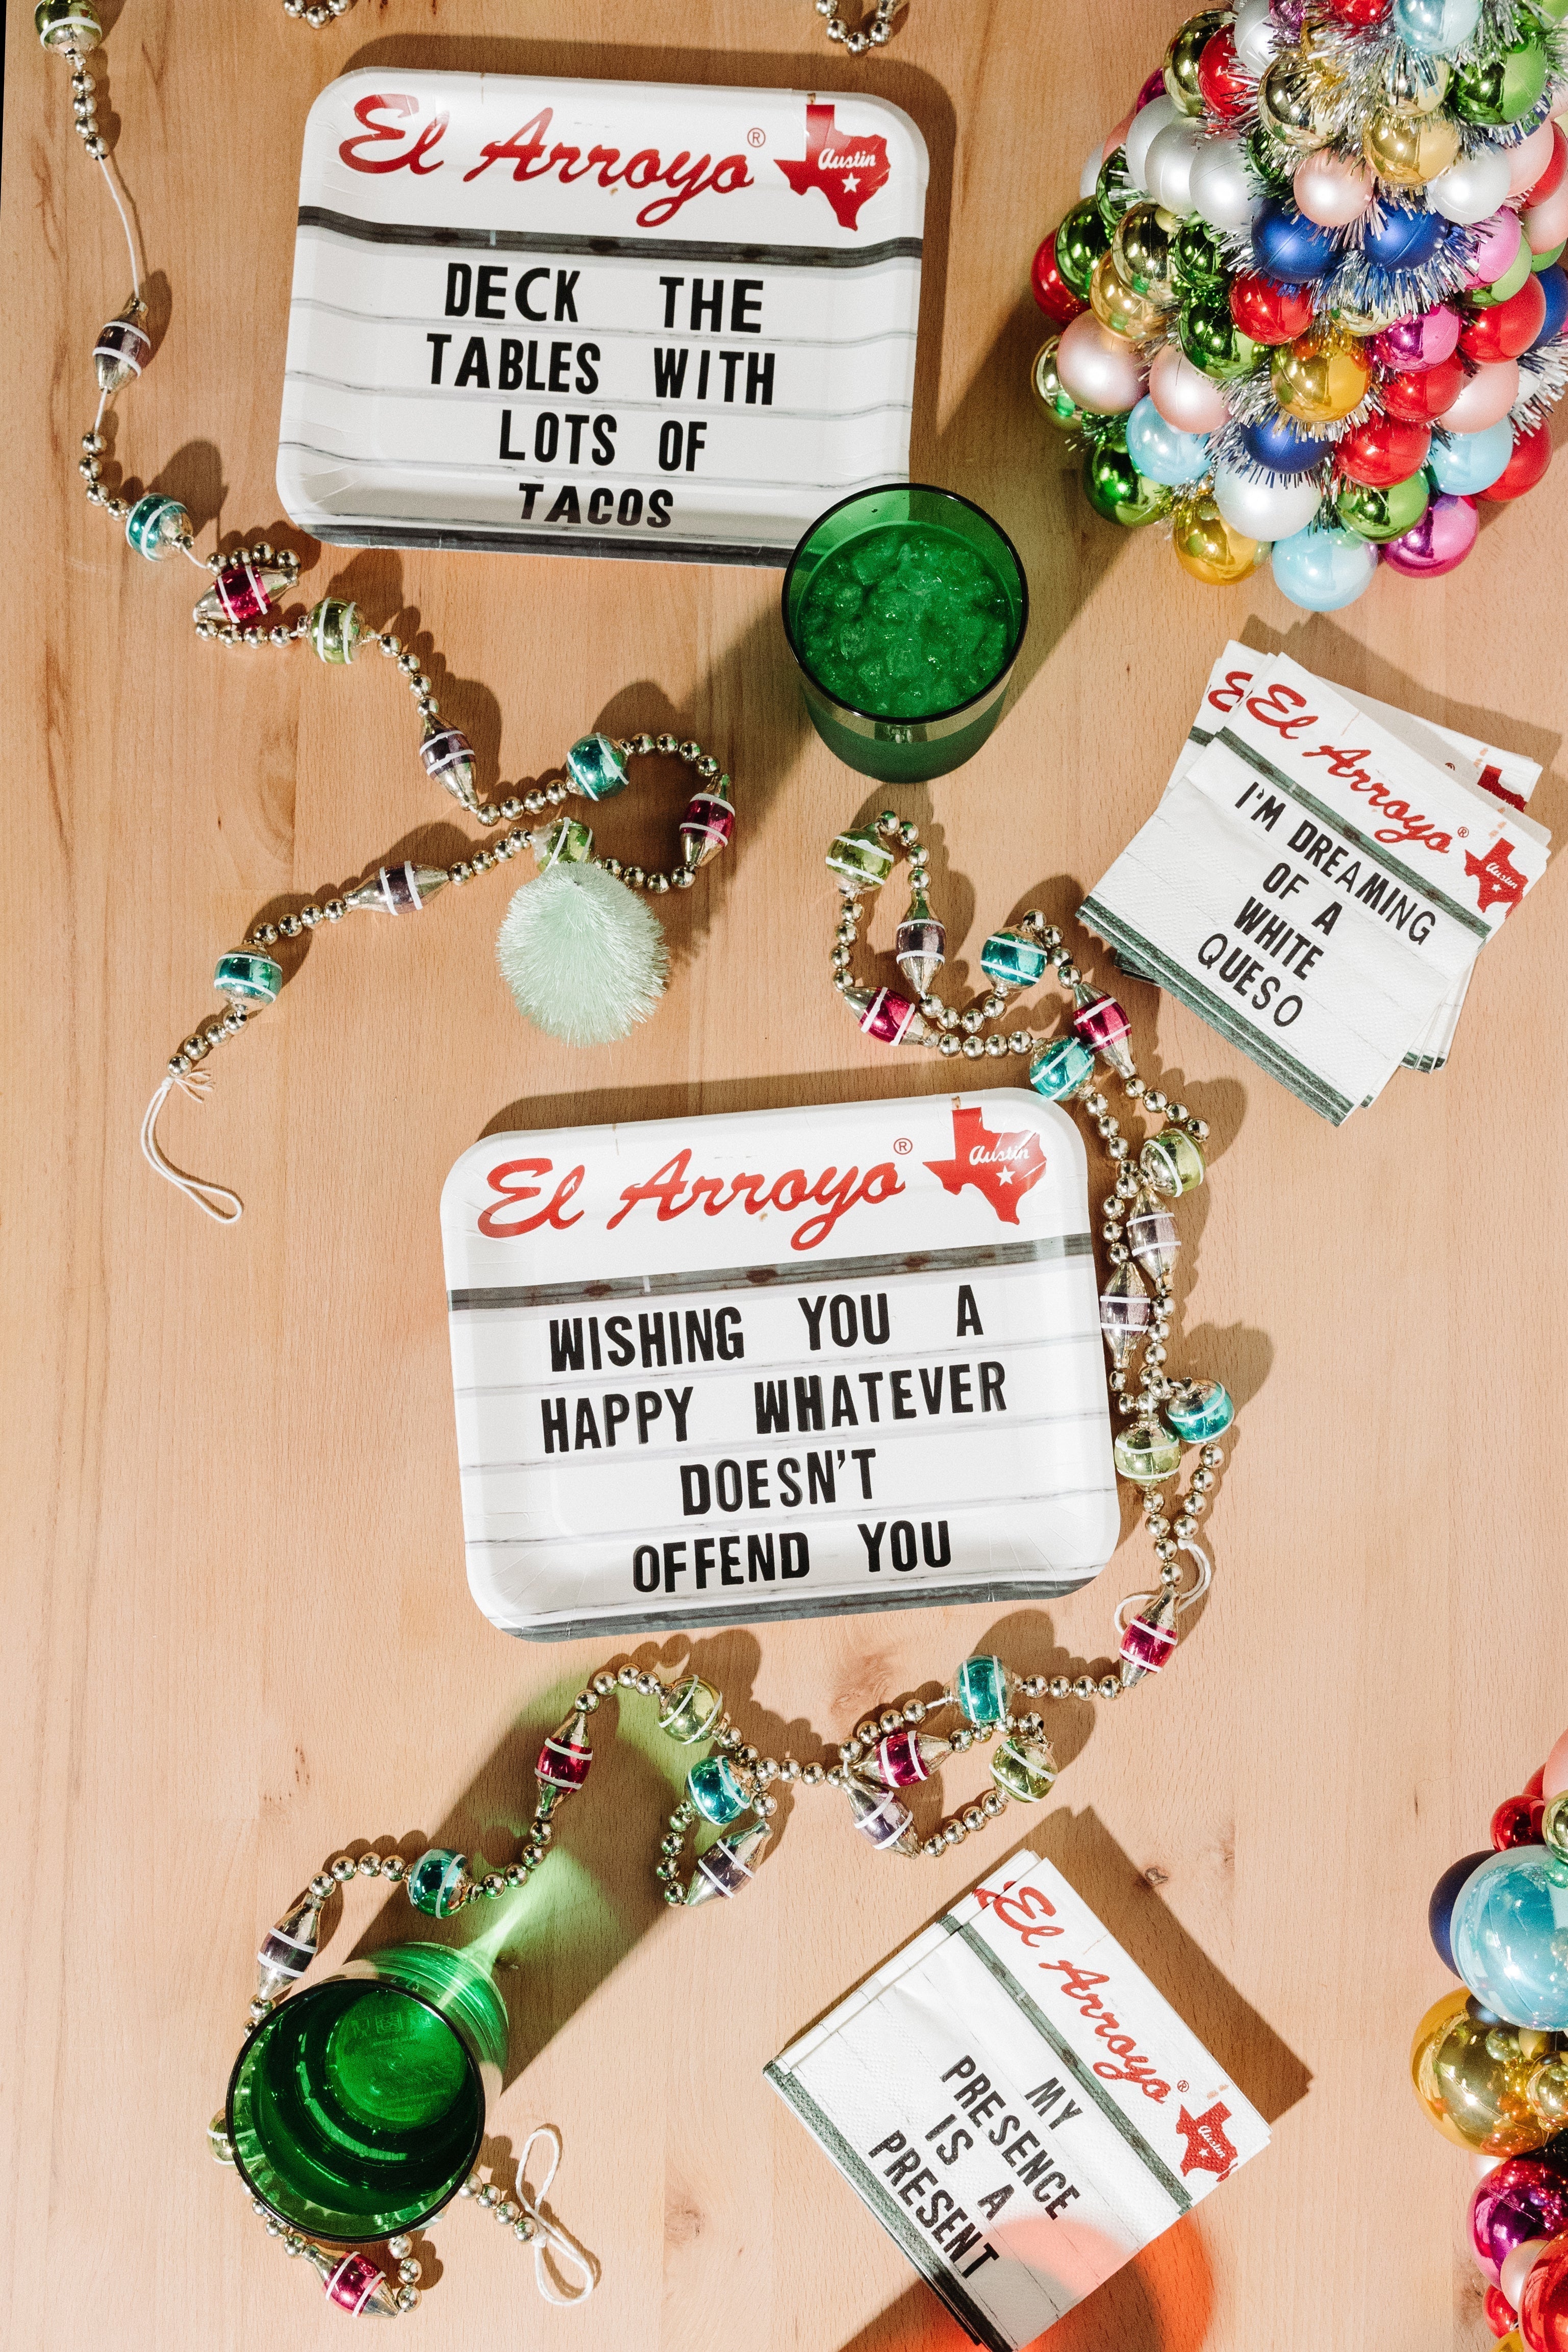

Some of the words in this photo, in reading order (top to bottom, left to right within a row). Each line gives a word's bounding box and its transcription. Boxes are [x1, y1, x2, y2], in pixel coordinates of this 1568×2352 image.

[339, 94, 449, 175] El
[463, 109, 754, 227] Arroyo
[818, 148, 876, 170] Austin
[445, 263, 580, 322] DECK
[660, 277, 763, 333] THE
[427, 333, 600, 394] TABLES
[654, 348, 775, 405] WITH
[499, 410, 617, 465] LOTS
[659, 420, 706, 471] OF
[519, 483, 673, 528] TACOS
[1246, 684, 1318, 739] El
[1303, 745, 1452, 853] Arroyo
[1235, 782, 1285, 832] I'M
[1287, 820, 1435, 945] DREAMING
[1263, 863, 1309, 899] OF
[1311, 902, 1342, 936] A
[1485, 862, 1518, 889] Austin
[1234, 896, 1324, 980] WHITE
[1197, 934, 1303, 1028] QUESO
[970, 1145, 1029, 1166] Austin
[478, 1158, 585, 1238] El
[606, 1149, 905, 1250] Arroyo
[550, 1307, 744, 1371] WISHING
[798, 1293, 890, 1350] YOU
[957, 1285, 983, 1336] A
[541, 1387, 693, 1454] HAPPY
[754, 1362, 1006, 1434] WHATEVER
[680, 1449, 875, 1515] DOESN'T
[633, 1533, 810, 1592] OFFEND
[858, 1521, 951, 1572] YOU
[994, 1887, 1064, 1947] El
[1039, 1961, 1171, 2104] Arroyo
[942, 2056, 1079, 2220] PRESENCE
[1025, 2076, 1082, 2131] MY
[1198, 2124, 1226, 2159] Austin
[869, 2130, 999, 2279] PRESENT
[925, 2114, 973, 2165] IS
[978, 2185, 1013, 2218] A
